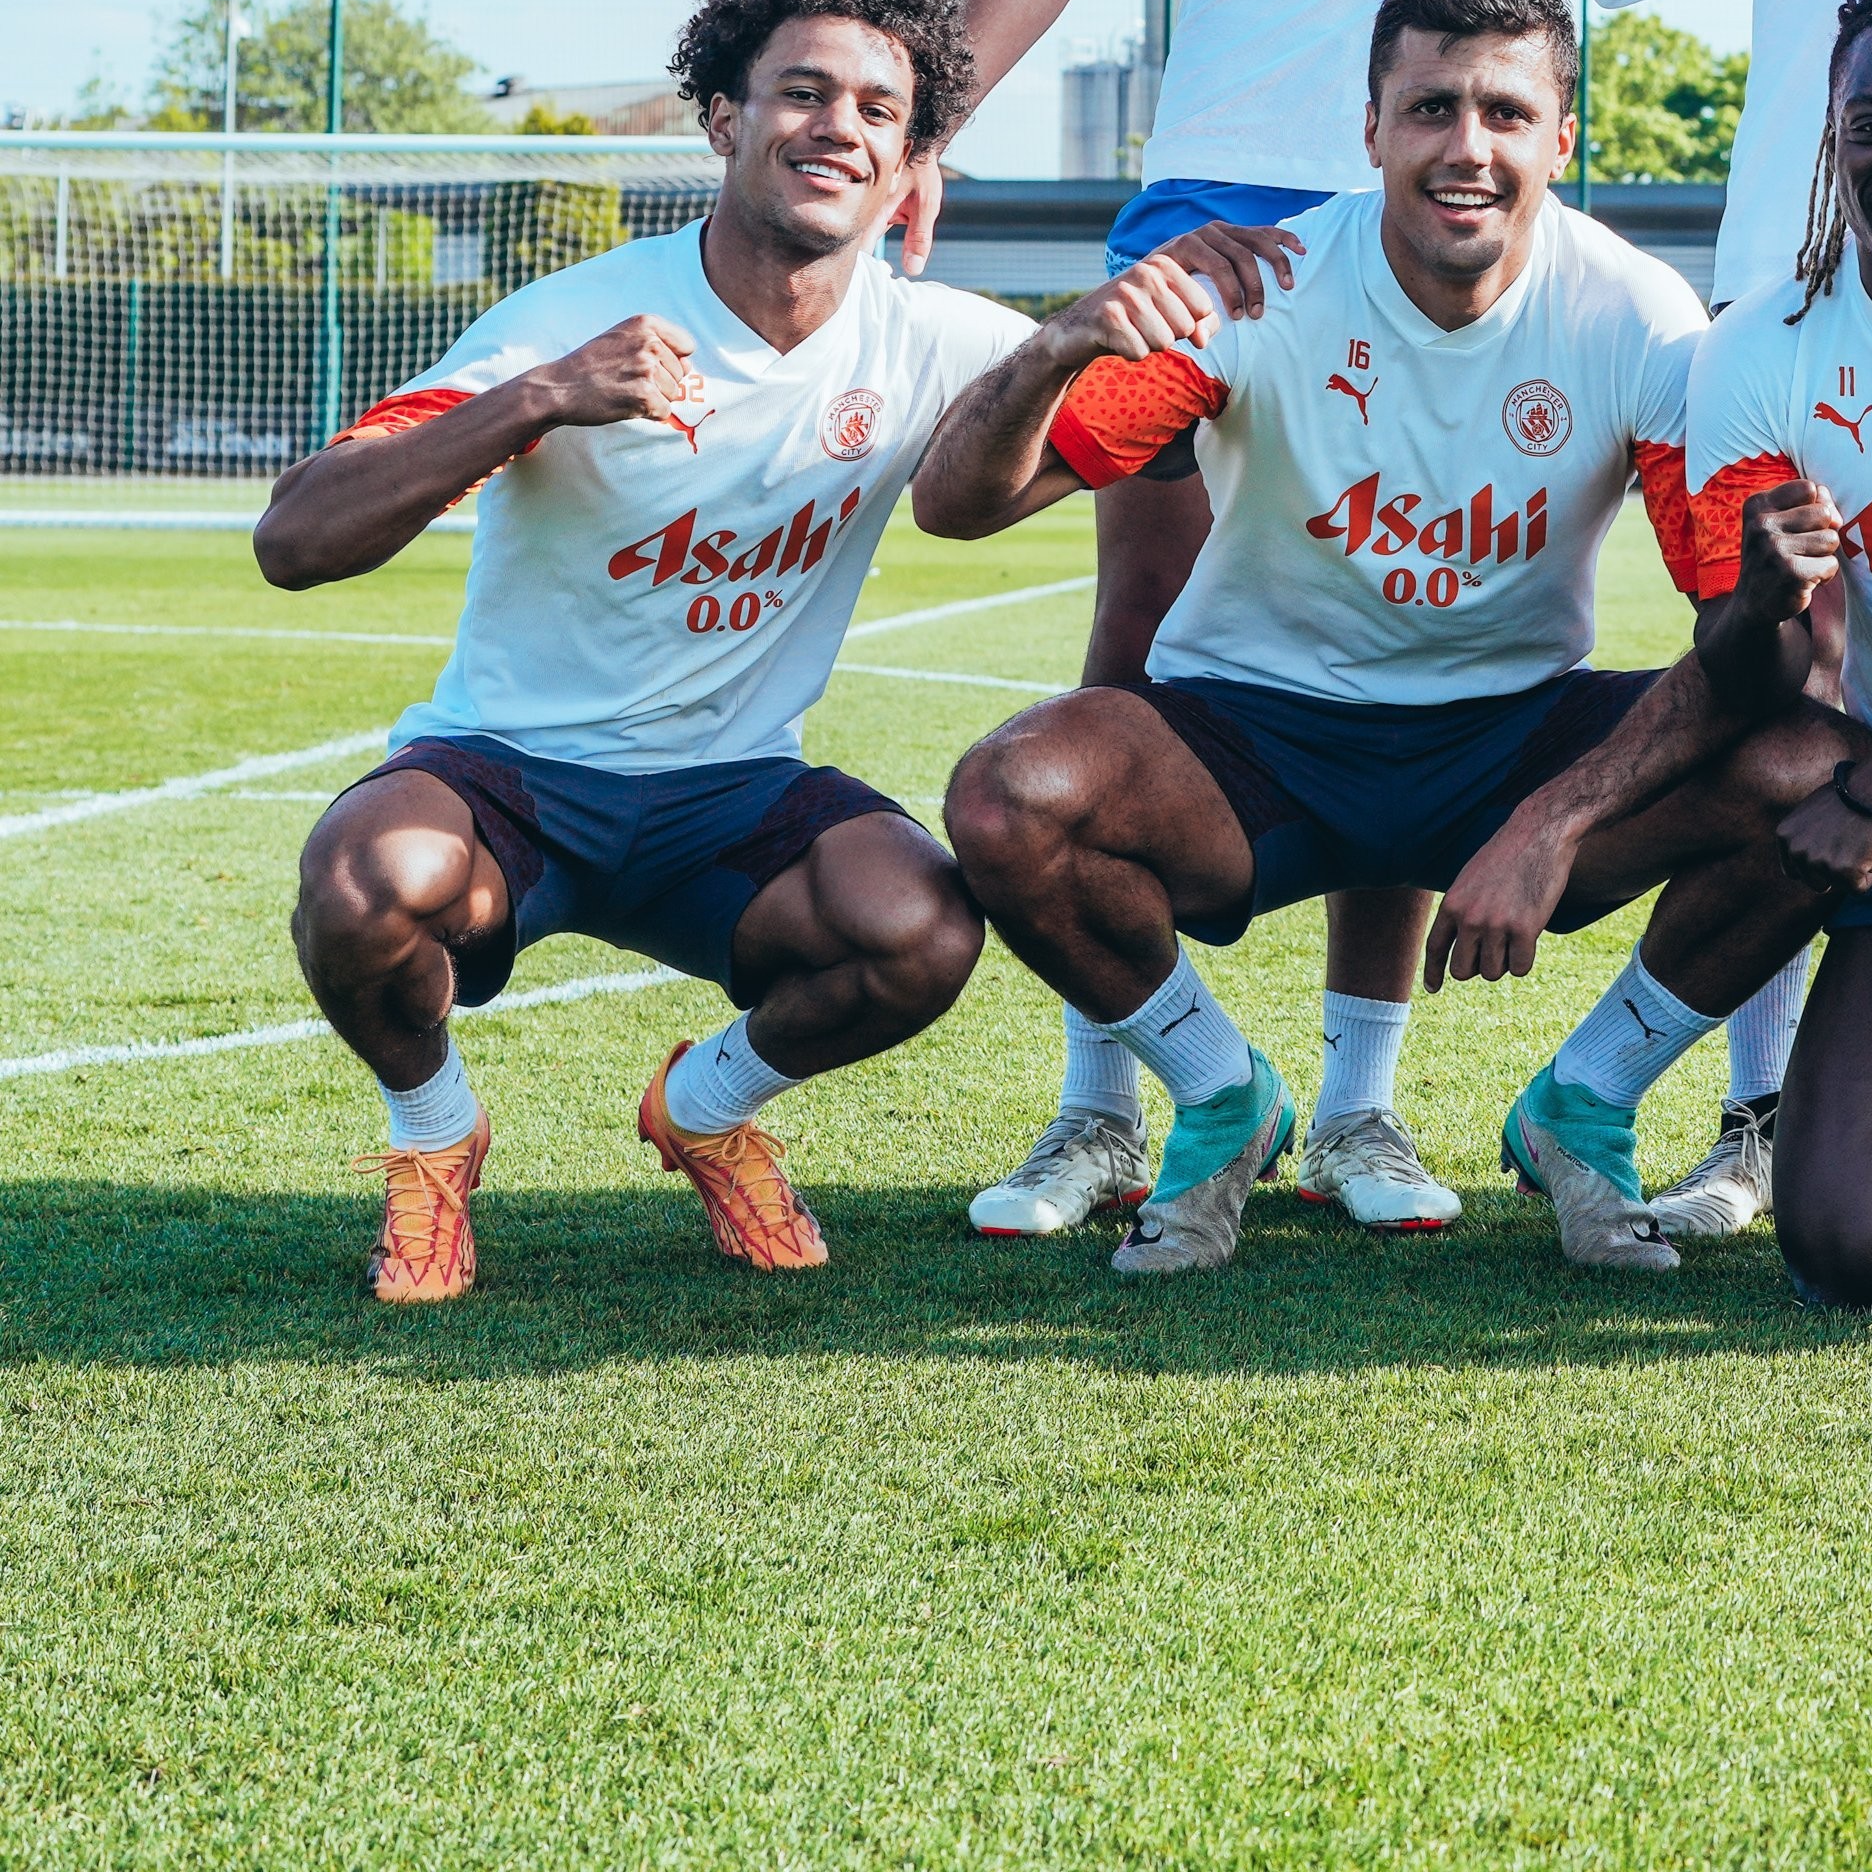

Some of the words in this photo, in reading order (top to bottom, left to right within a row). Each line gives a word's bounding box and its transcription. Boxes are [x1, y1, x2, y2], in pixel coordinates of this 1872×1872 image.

[1347, 338, 1371, 370] 16
[1838, 366, 1855, 397] 11
[841, 447, 863, 457] CITY
[1526, 442, 1549, 452] CITY
[1306, 471, 1547, 565] Asahi
[1382, 566, 1483, 609] 0.0%
[686, 588, 784, 634] 0.0%
